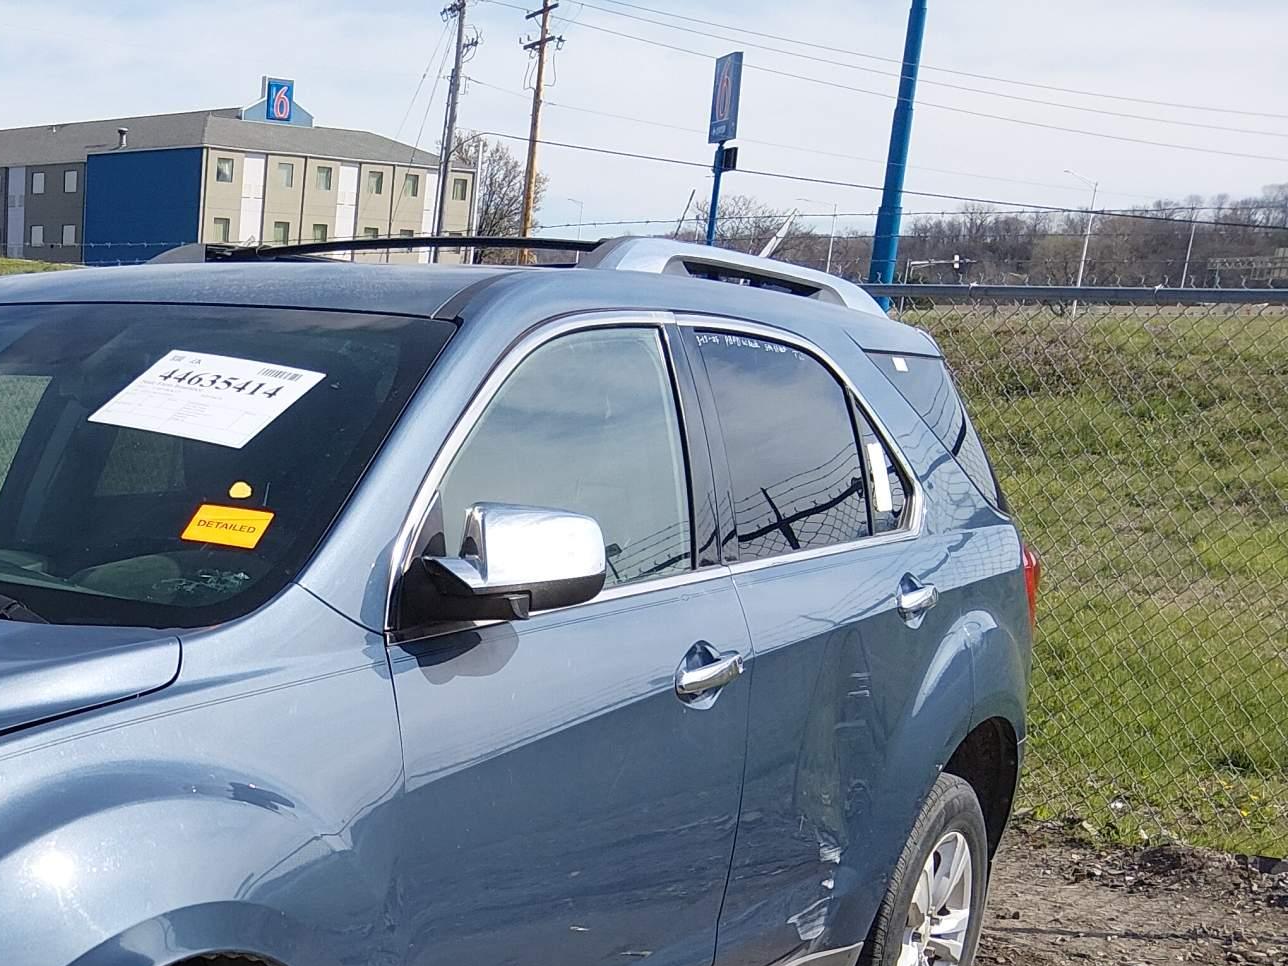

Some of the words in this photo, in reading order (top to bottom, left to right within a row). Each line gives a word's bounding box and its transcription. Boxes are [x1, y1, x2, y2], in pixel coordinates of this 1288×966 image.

[274, 86, 289, 119] 6
[159, 369, 284, 399] 44635414
[197, 519, 256, 534] DETAILED
